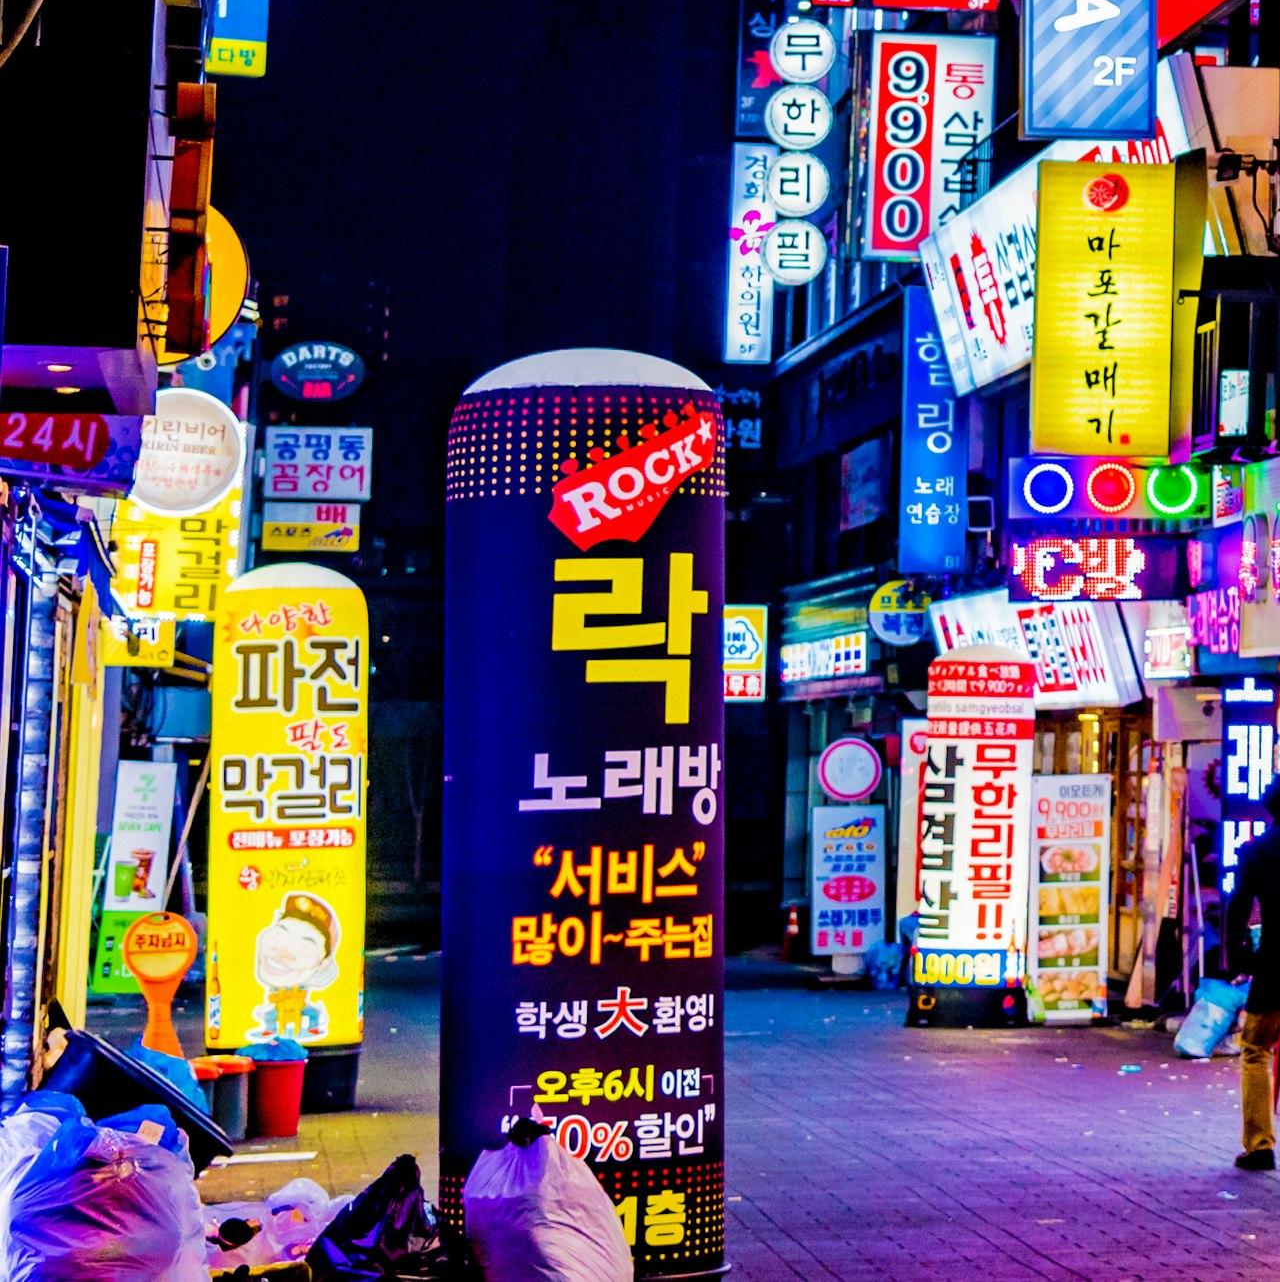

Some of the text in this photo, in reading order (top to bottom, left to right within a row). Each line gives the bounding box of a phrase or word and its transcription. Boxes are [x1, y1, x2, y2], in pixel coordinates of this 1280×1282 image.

[1092, 56, 1137, 87] 2F
[775, 34, 824, 273] 무한리필
[738, 265, 765, 337] 한의원
[282, 344, 355, 368] DARTS
[1084, 227, 1122, 445] 마포갈매기
[3, 411, 98, 462] 24시
[141, 418, 226, 444] 기린비어
[183, 444, 217, 456] BEER
[273, 432, 366, 461] 공평동
[272, 462, 365, 493] 꼼장어
[562, 430, 702, 533] ROCK
[626, 486, 670, 512] MUSIC
[914, 476, 955, 496] 노래
[906, 504, 960, 525] 연습장
[137, 541, 159, 607] 포장가능
[240, 602, 332, 635] 다양한
[551, 552, 709, 725] 락
[236, 639, 360, 713] 파전
[287, 720, 350, 752] 팔도
[223, 755, 363, 821] 막걸리
[519, 744, 722, 825] 노래방
[231, 828, 354, 849] 전메뉴 포장가능
[917, 744, 964, 940] 삼겹살
[515, 987, 715, 1040] 학생 大 환영!
[533, 1063, 701, 1106] 오후6시 이전
